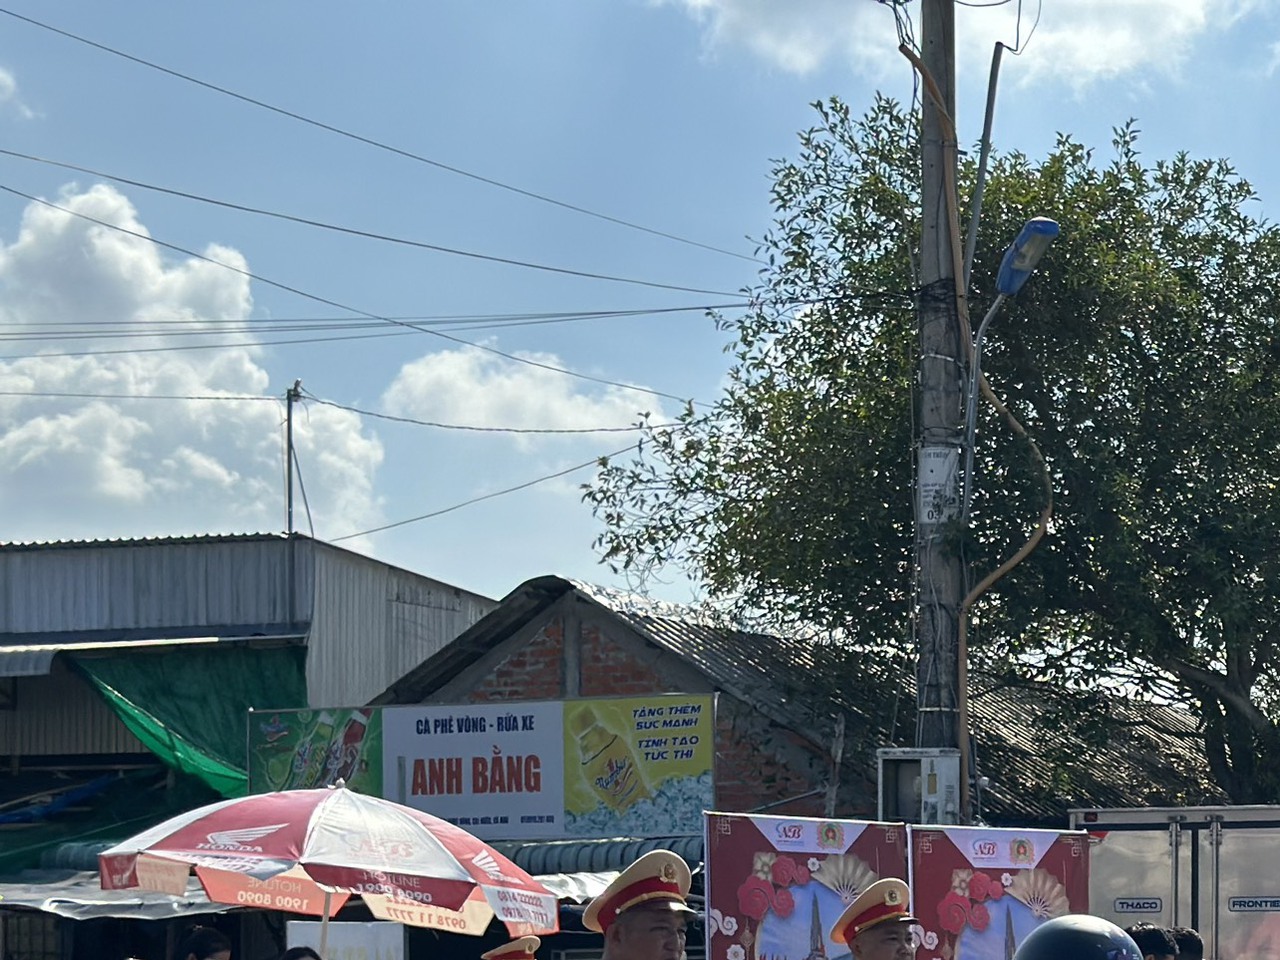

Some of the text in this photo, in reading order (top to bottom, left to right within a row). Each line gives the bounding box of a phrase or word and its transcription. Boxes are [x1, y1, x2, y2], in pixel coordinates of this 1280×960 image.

[522, 715, 535, 731] XE
[411, 756, 463, 796] ANH
[472, 745, 541, 794] BẰNG
[195, 843, 264, 853] HONDA
[1119, 901, 1158, 910] THACO
